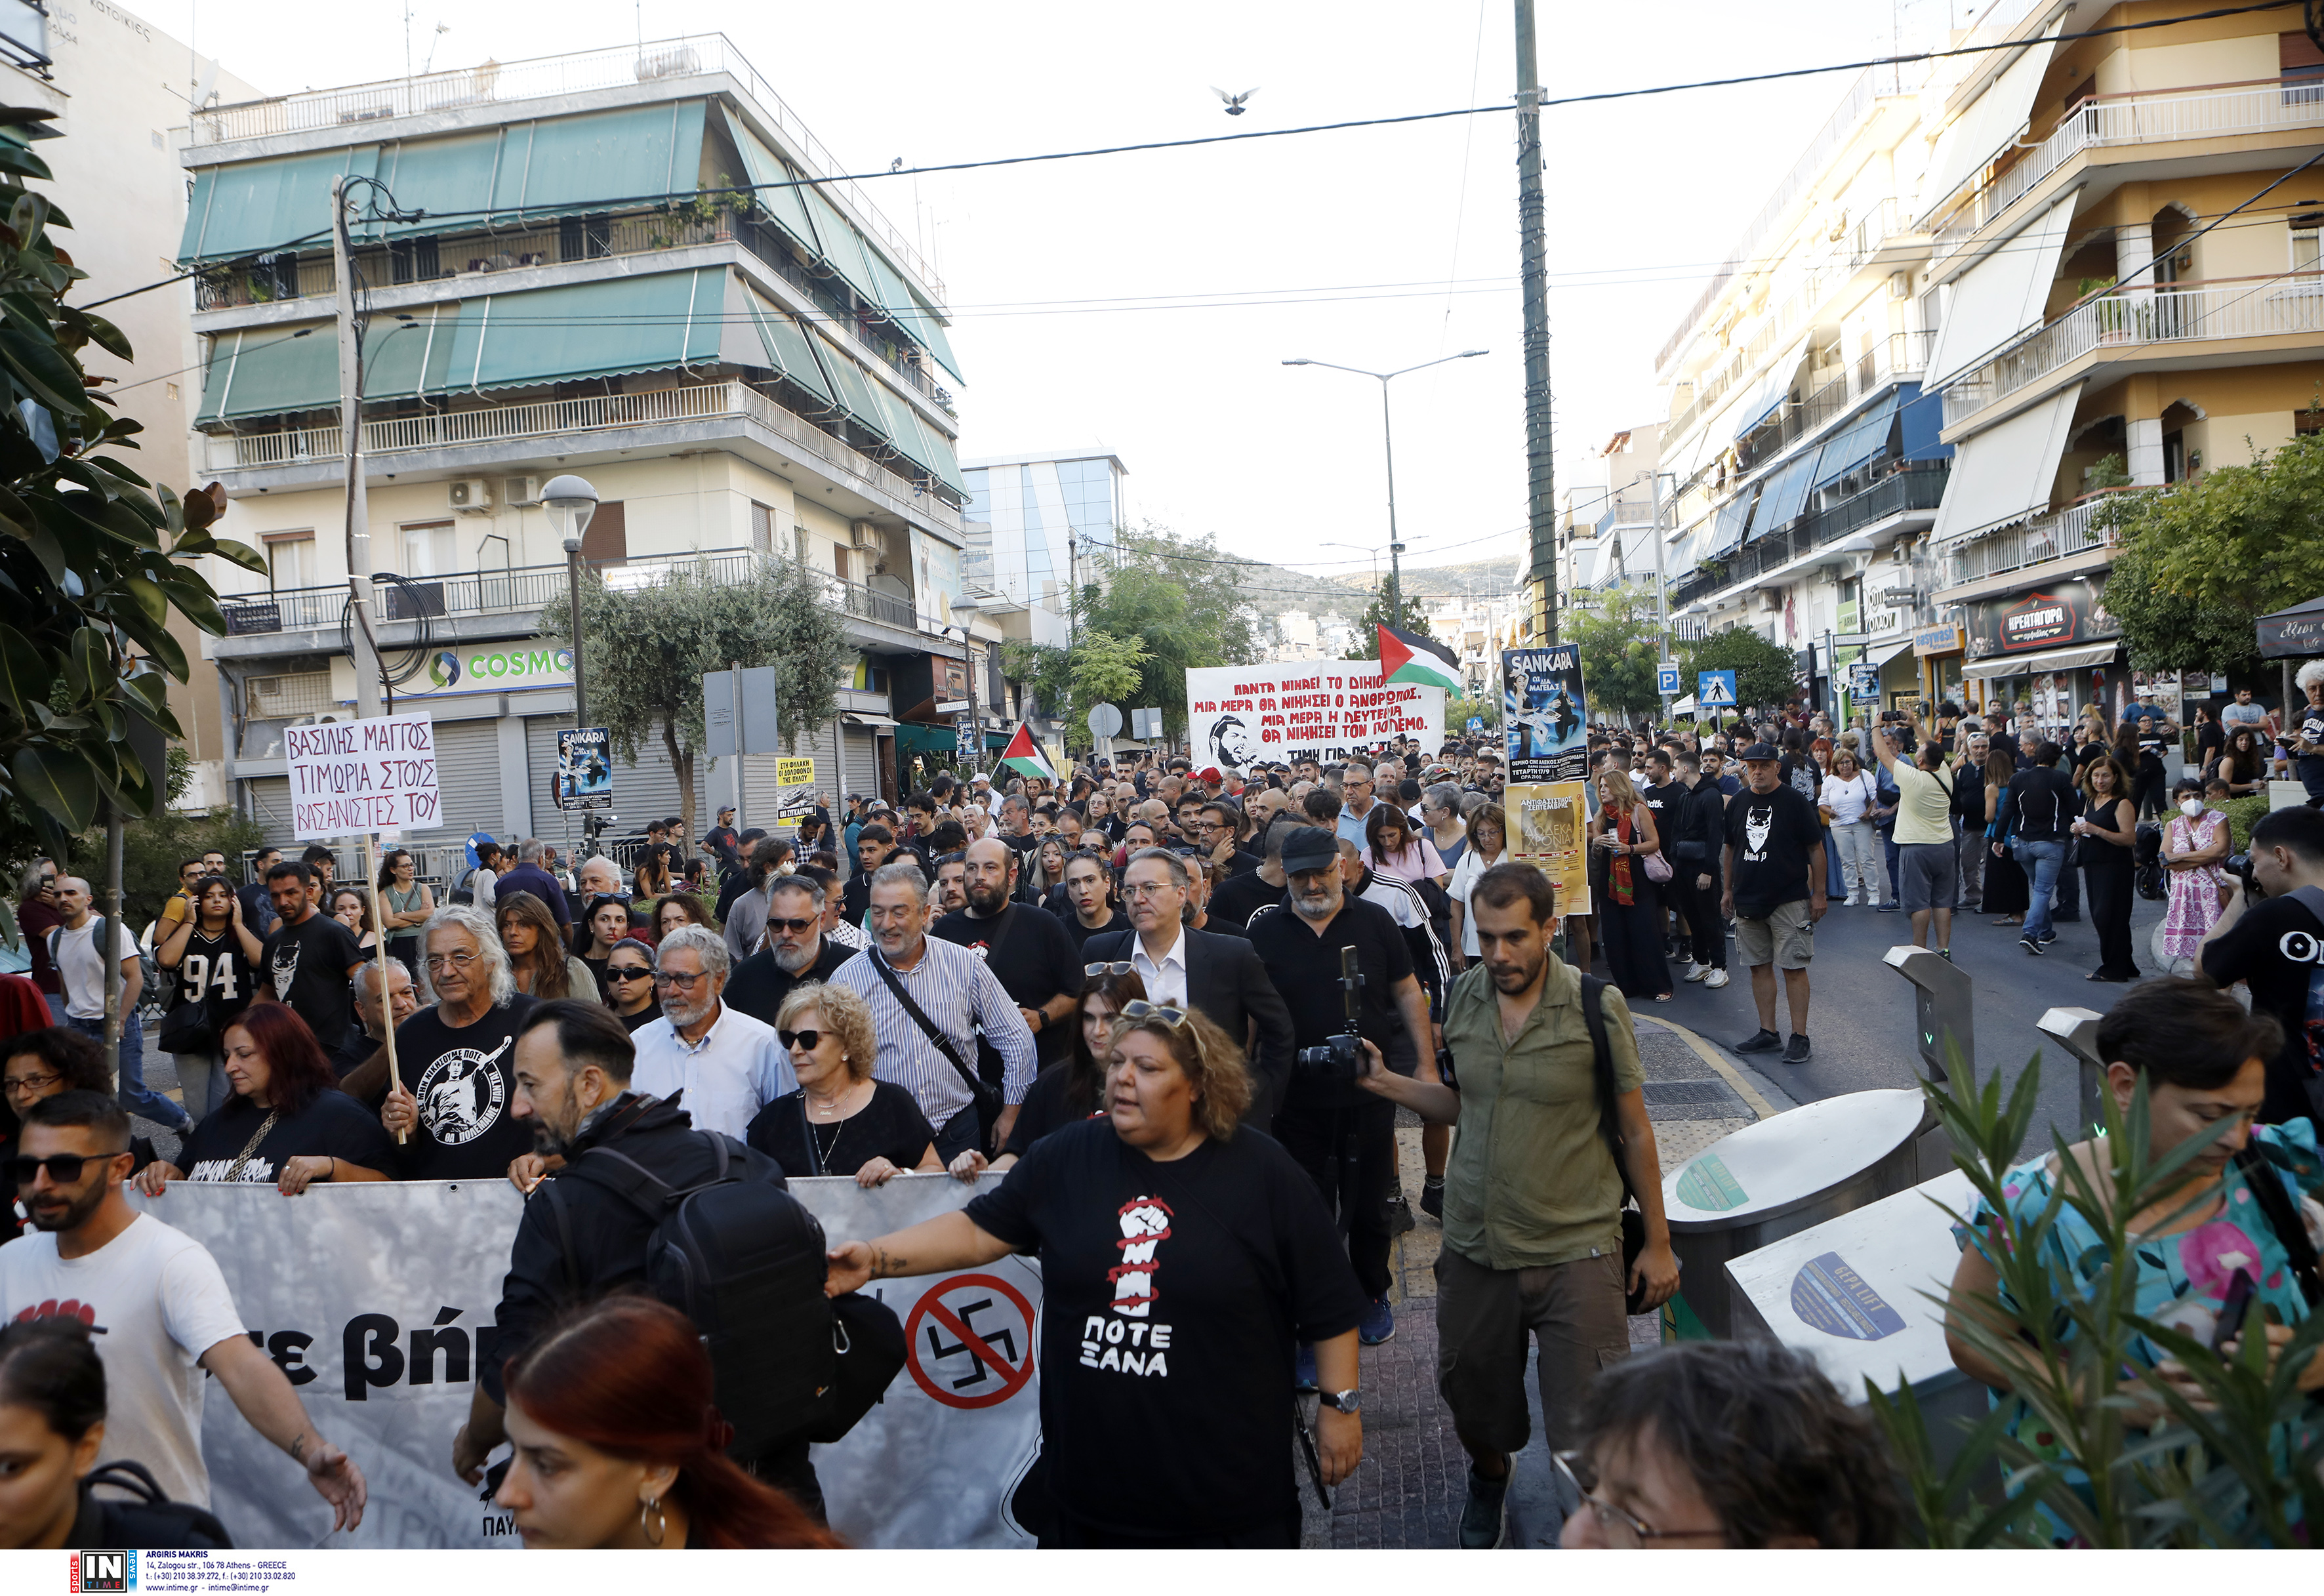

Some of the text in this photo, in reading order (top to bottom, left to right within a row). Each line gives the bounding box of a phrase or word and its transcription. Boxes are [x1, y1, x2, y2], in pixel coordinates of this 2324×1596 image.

[1835, 635, 1867, 644] ΜΑΓΝΗΣΙΑΣ
[1915, 625, 1954, 648] easywash
[1511, 652, 1574, 672] SANKARA
[1234, 682, 1276, 695] ΠΑΝΤΑ
[1281, 676, 1320, 691] ΝΙΚΑΕΙ
[1326, 676, 1342, 689] ΤΟ
[1529, 683, 1560, 691] ΜΑΓΕΙΑΣ
[1662, 674, 1674, 688] P
[938, 702, 968, 711] ΜΑΓΝΗΣΙΑΣ
[1194, 701, 1217, 712] ΜΙΑ
[1220, 699, 1253, 712] ΜΕΡΑ
[1259, 698, 1276, 711] ΘΑ
[1281, 694, 1330, 709] ΝΙΚΗΣΕΙ
[1335, 694, 1344, 708] Ο
[1261, 706, 1402, 726] ΜΙΑ ΜΕΡΑ Η ΛΕΥΤΕΡΙΑ
[288, 722, 430, 760] ΒΑΣΙΛΗΣ ΜΑΓΓΟΣ
[563, 731, 606, 745] SANKARA
[1261, 729, 1281, 743] ΘΑ
[1286, 726, 1335, 741] ΝΙΚΗΣΕΙ
[1342, 724, 1367, 739] ΤΟΝ
[1287, 749, 1320, 762] ΤΙΜΗ
[295, 758, 436, 794] ΤΙΜΩΡΙΑ ΣΤΟΥΣ
[785, 767, 812, 776] ΔΟΛΟΦΟΝΟΙ
[1521, 796, 1572, 806] ΑΝΤΙΦΑΣΙΣΤΙΚΟΣ
[1528, 802, 1568, 811] ΣΕΠΤΕΜΒΡΗΣ
[296, 790, 438, 831] ΒΑΣΑΝΙΣΤΕΣ ΤΟΥ
[787, 806, 813, 817] ΣΥΓΚΑΛΥΨΗ!
[1524, 823, 1572, 836] ΔΩΔΕΚΑ
[1527, 834, 1571, 846] ΧΡΟΝΙΑ
[183, 952, 238, 1003] 94
[464, 1050, 482, 1061] ΠΟΤΕ
[425, 1050, 462, 1080] ΝΙΚΗΣΟΥΜΕ
[417, 1082, 426, 1100] ΜΗΝ
[423, 1114, 436, 1129] ΚΑΙ
[445, 1132, 455, 1143] ΘΑ
[459, 1105, 499, 1142] ΠΟΛΕΜΑΜΕ
[1834, 1266, 1863, 1290] GEPA
[1856, 1288, 1886, 1312] LIFT
[1084, 1316, 1172, 1348] ΠΟΤΕ
[1080, 1340, 1168, 1377] ΞΑΝΑ
